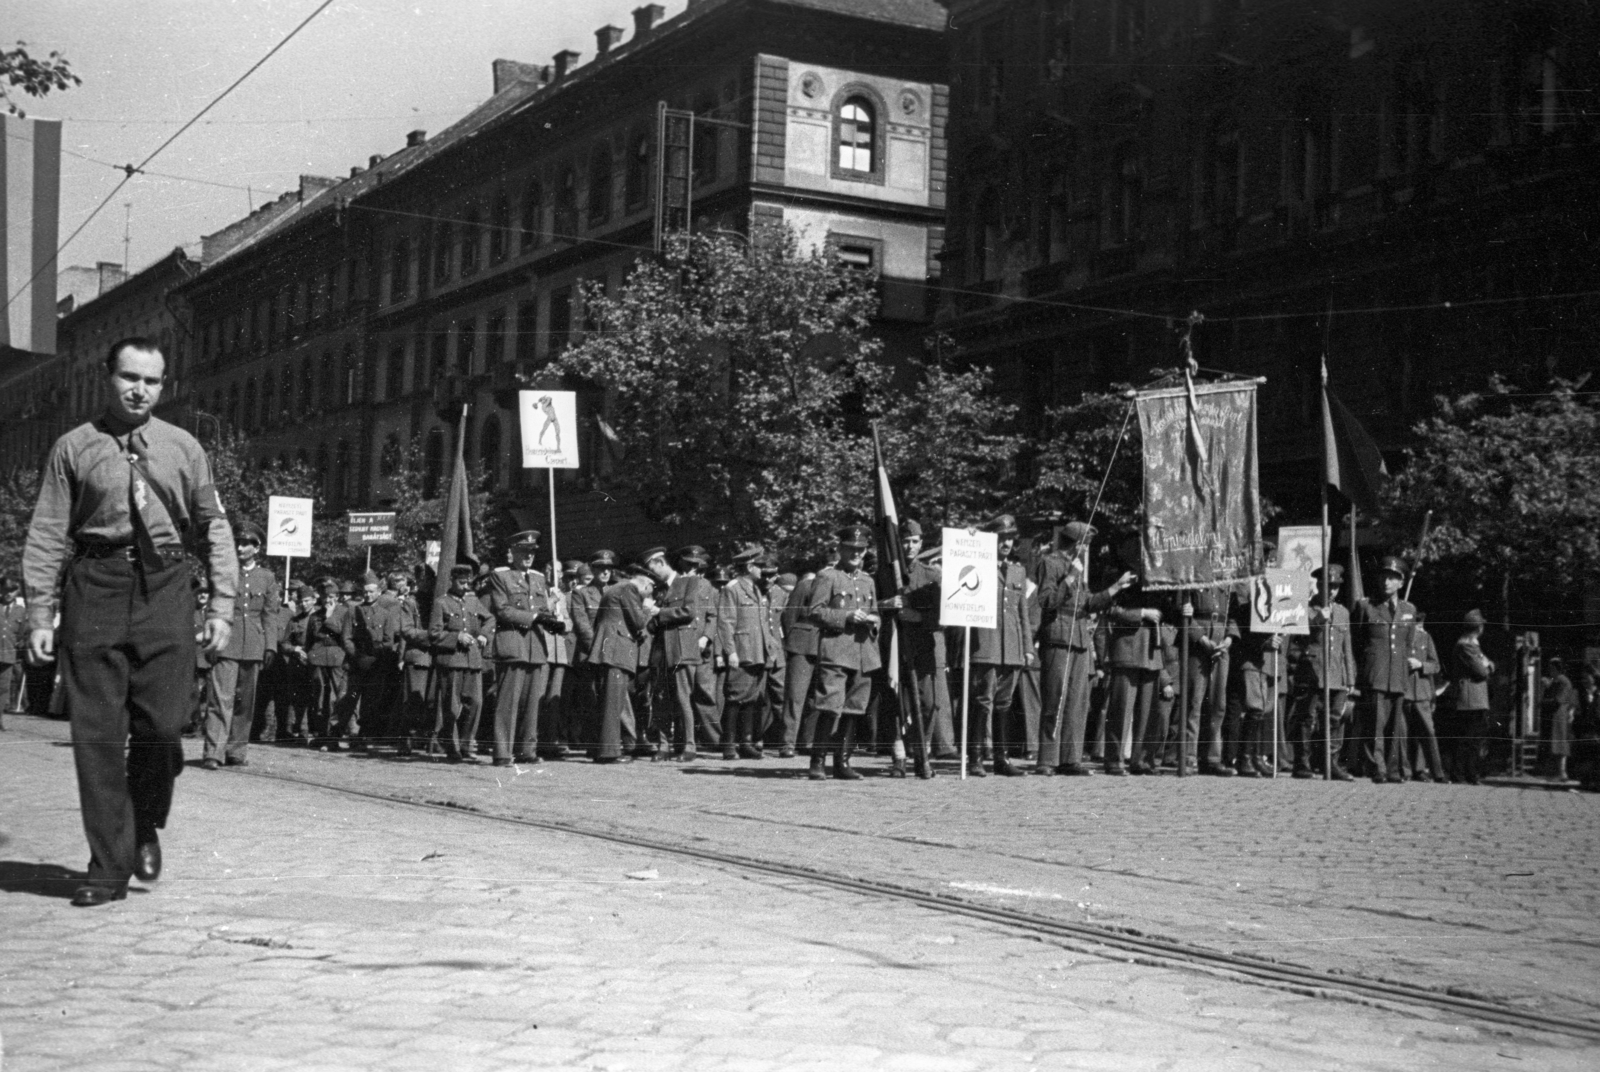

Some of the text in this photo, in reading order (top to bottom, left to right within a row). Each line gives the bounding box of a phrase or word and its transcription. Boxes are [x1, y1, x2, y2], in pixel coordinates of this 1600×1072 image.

[955, 538, 981, 548] NEMZETI
[950, 549, 993, 561] PARASZT PÁRT
[945, 600, 986, 612] HONVÉDELMI
[965, 614, 994, 624] CSOPORT
